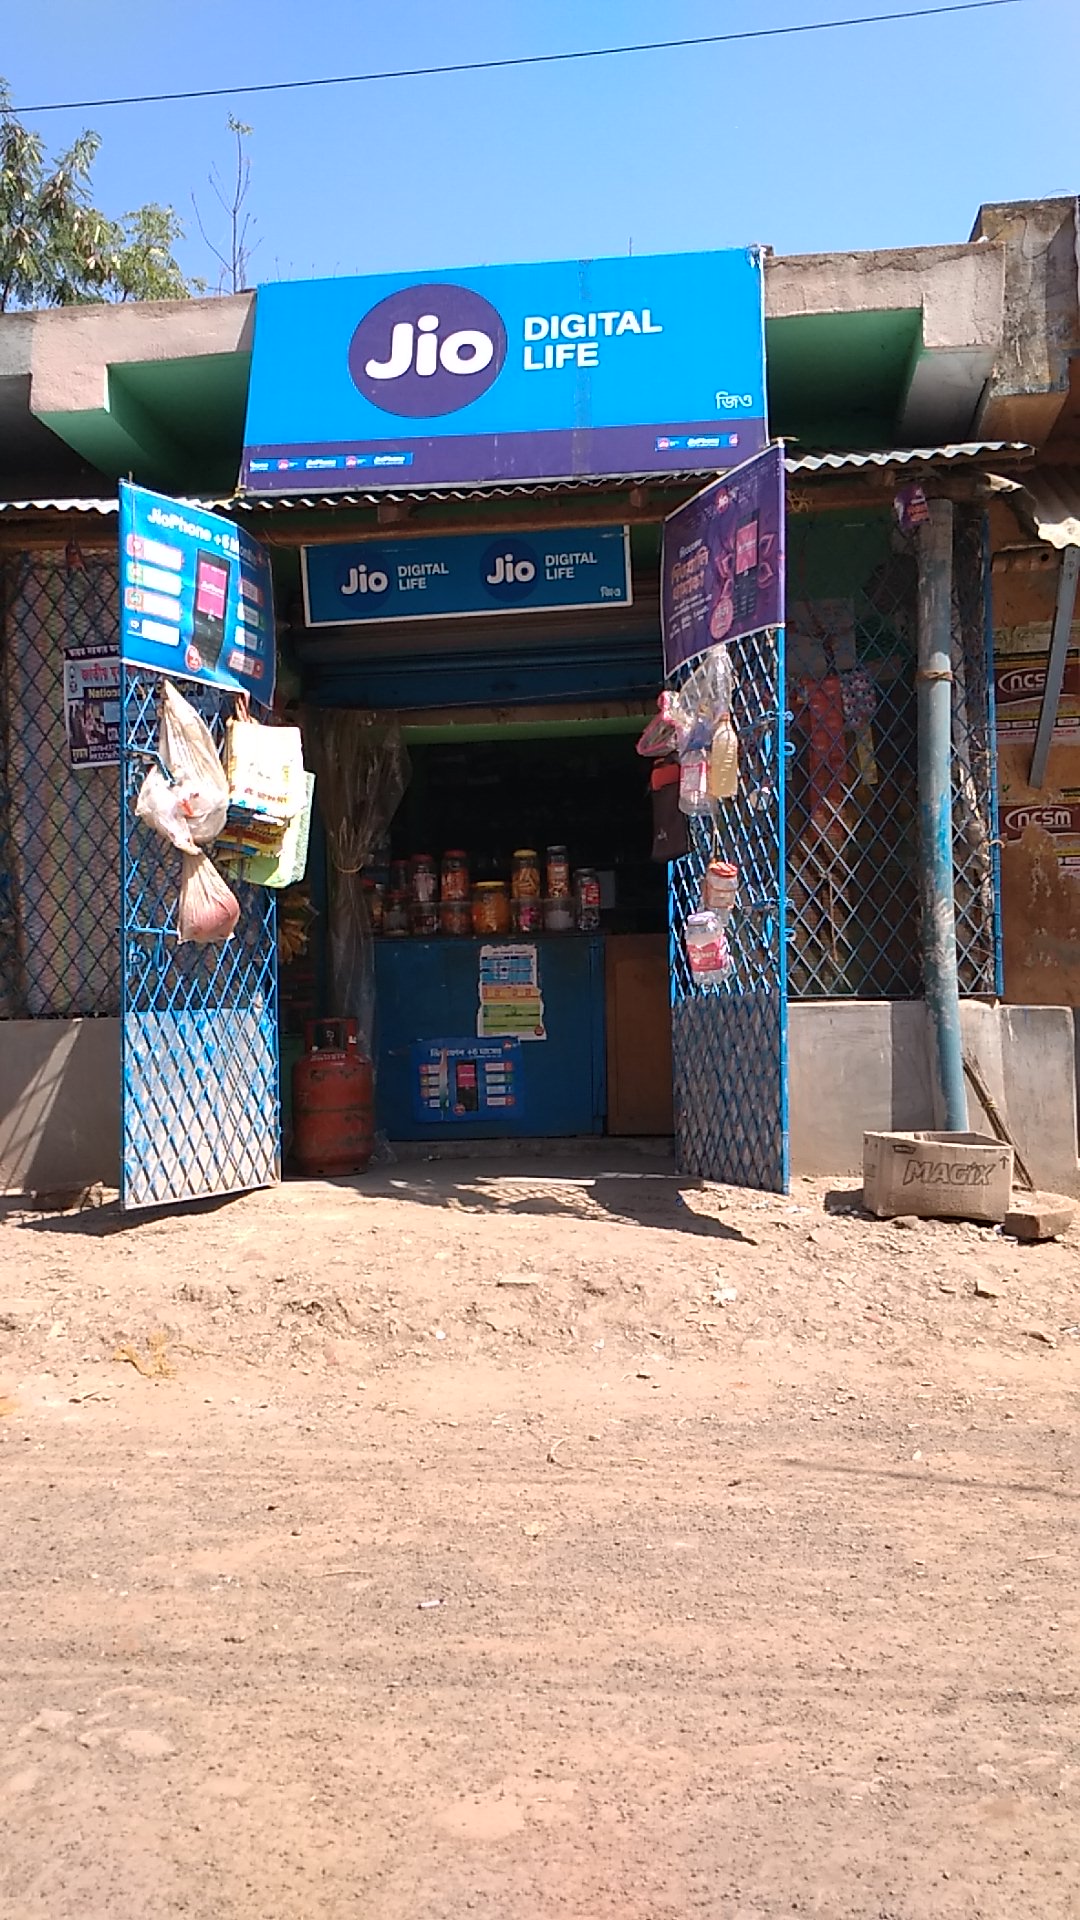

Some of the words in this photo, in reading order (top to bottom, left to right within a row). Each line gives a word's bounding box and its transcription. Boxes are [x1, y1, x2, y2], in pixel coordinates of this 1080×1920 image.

[523, 309, 663, 341] DIGITAL
[364, 314, 494, 380] Jio
[523, 342, 599, 371] LIFE
[715, 391, 753, 410] জিও
[147, 507, 212, 542] JioPhone
[397, 562, 449, 577] DIGITAL
[486, 553, 535, 584] Jio
[545, 551, 597, 567] DIGITAL
[341, 564, 388, 595] Jio
[398, 577, 427, 591] LIFE
[546, 567, 575, 580] LIFE
[1009, 672, 1063, 688] ncs
